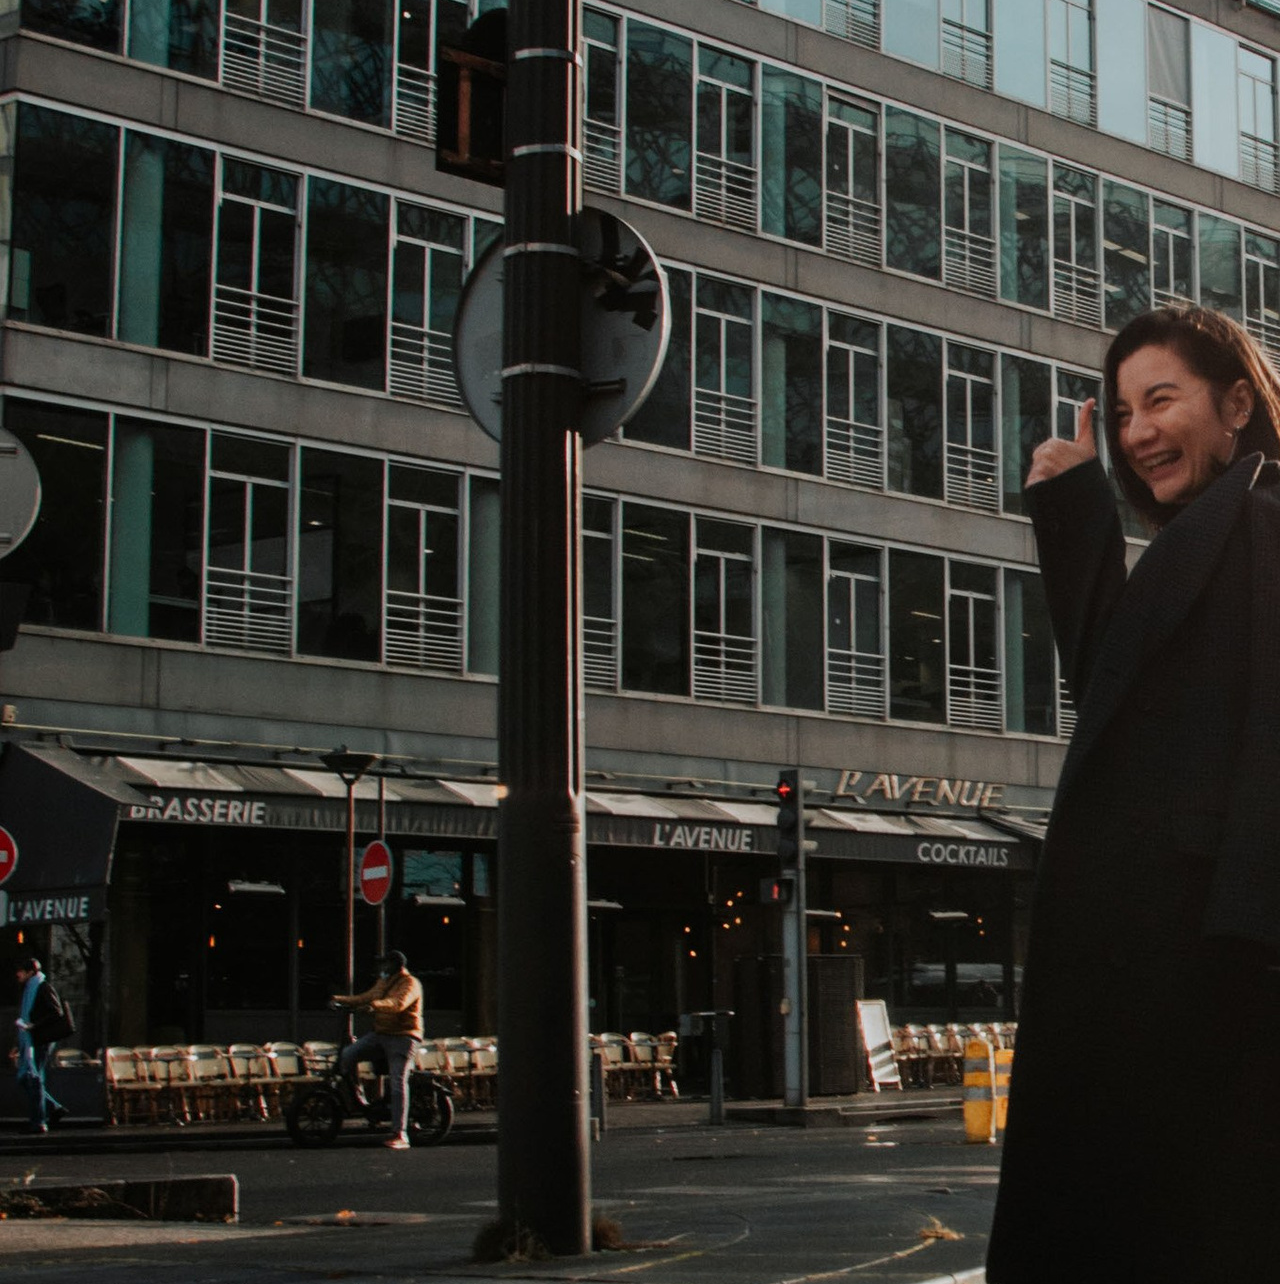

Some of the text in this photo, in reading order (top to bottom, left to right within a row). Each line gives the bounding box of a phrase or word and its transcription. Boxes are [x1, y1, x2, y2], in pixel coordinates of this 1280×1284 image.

[653, 823, 752, 850] L'AVENUE
[917, 842, 1009, 866] COCKTAILS
[9, 897, 90, 922] L'AVENUE
